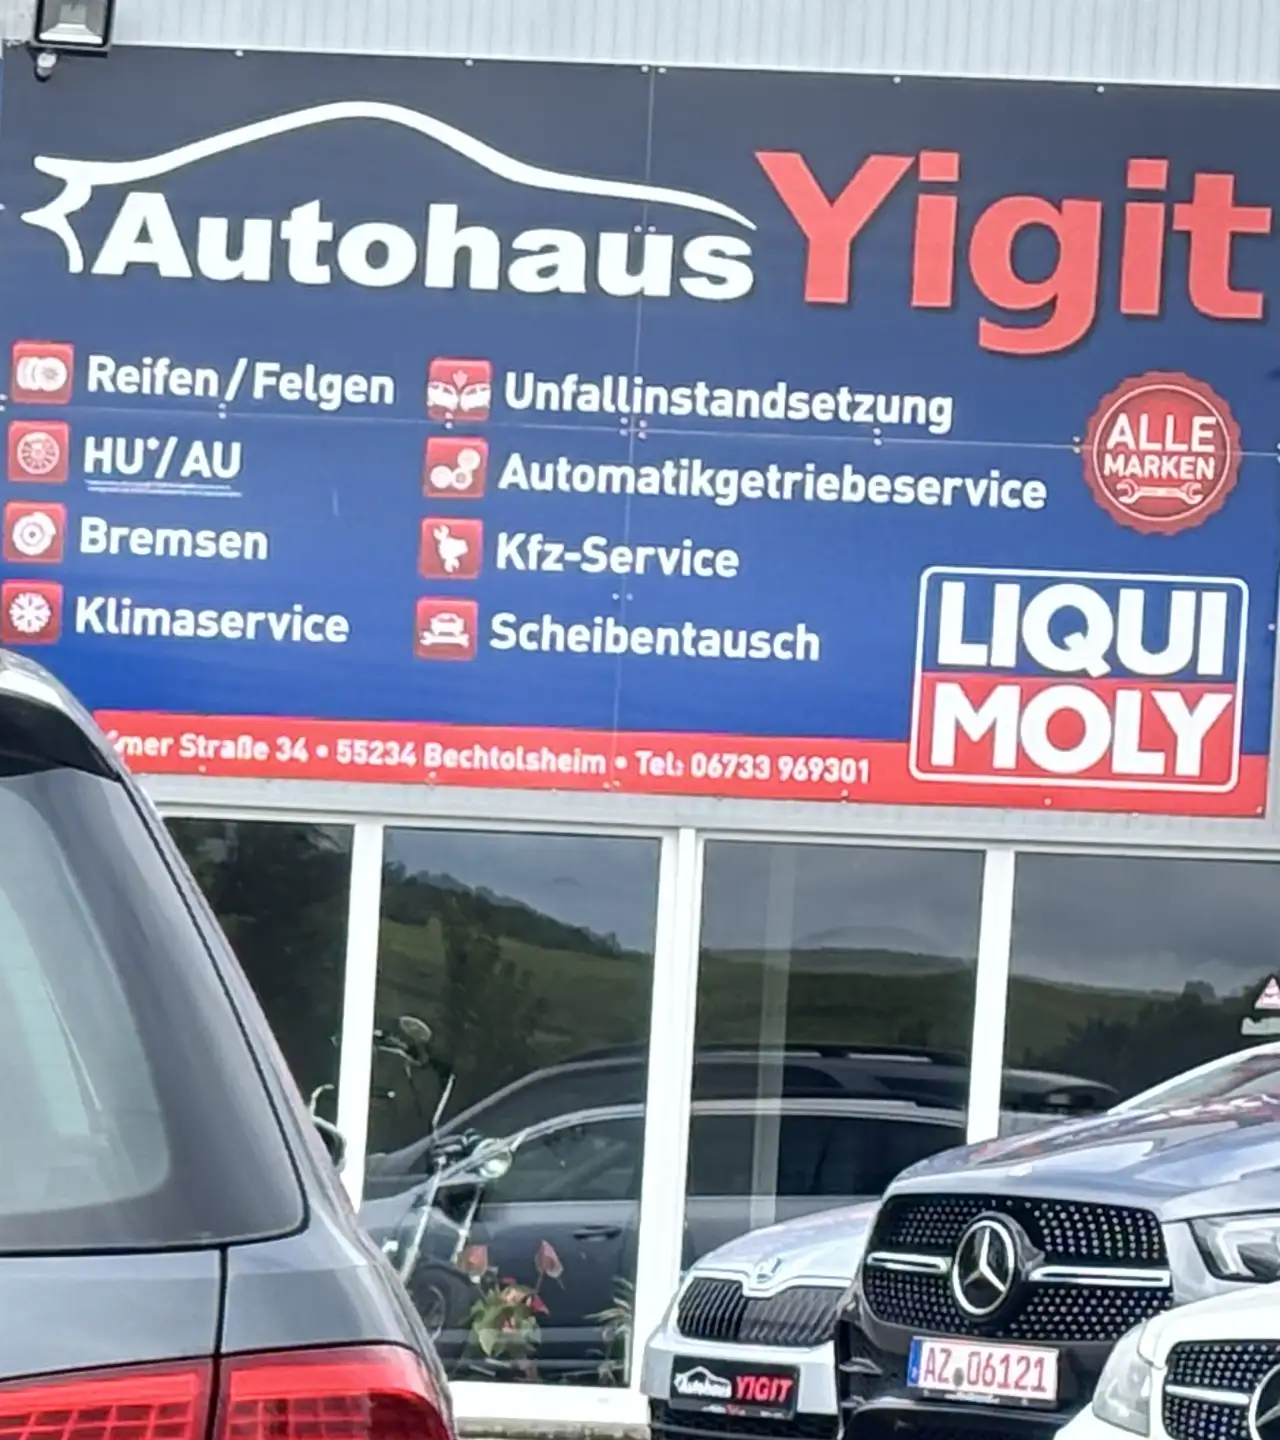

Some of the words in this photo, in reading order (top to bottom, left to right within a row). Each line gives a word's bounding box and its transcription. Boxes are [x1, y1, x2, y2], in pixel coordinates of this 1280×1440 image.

[91, 192, 754, 300] Autohaus
[755, 150, 1272, 353] Yigit
[504, 372, 954, 434] Unfallinstandsetzung
[1107, 412, 1217, 452] ALLE
[498, 453, 1048, 508] Automatikgetriebeservice
[1103, 453, 1215, 480] MARKEN
[80, 516, 268, 560] Bremsen
[496, 533, 739, 578] Kfz-Service
[75, 596, 350, 643] Klimaservice
[489, 613, 821, 661] Scheibentausch
[937, 581, 1228, 678] LIQUI
[931, 682, 1233, 777] MOLY
[178, 732, 270, 761] Straße
[275, 736, 310, 763] 34
[336, 739, 417, 767] 55234
[424, 743, 607, 774] Bechtolsheim
[690, 752, 770, 780] 06733
[777, 755, 870, 785] 969301
[735, 1375, 793, 1402] YIGIT
[924, 1347, 952, 1384] AZ
[966, 1351, 1047, 1393] 06121
